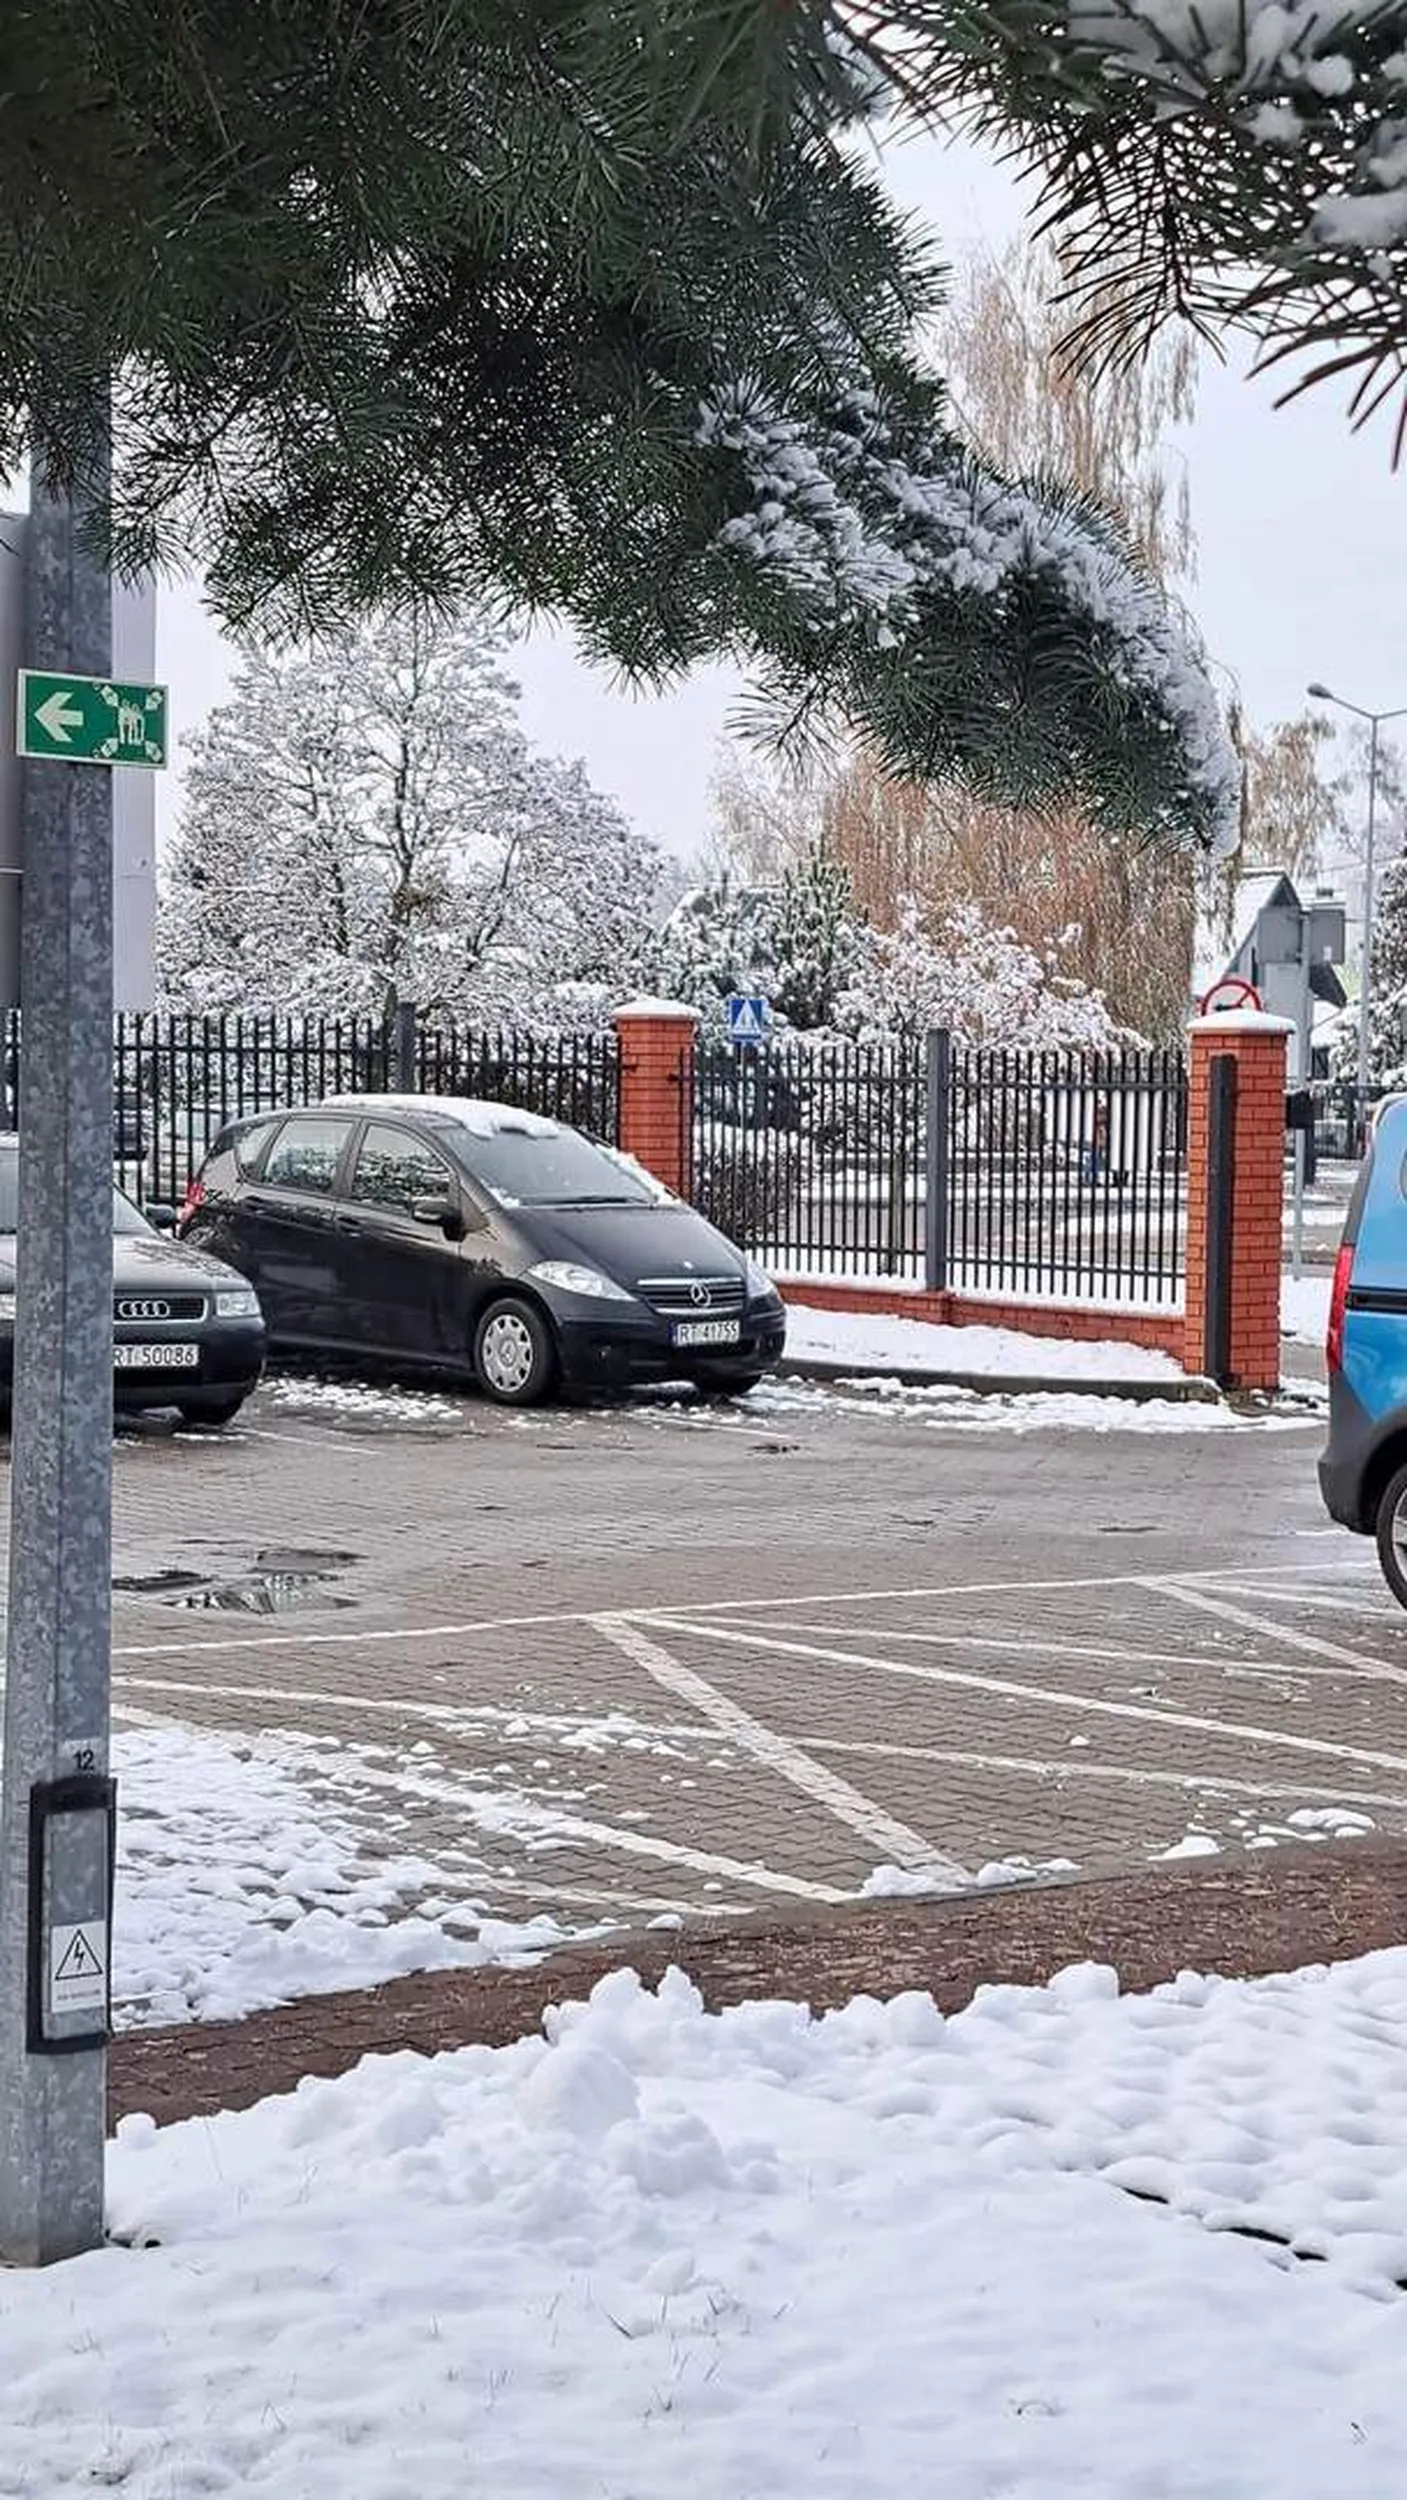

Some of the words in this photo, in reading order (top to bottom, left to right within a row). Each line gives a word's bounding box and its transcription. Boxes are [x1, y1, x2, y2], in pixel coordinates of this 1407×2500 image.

[680, 1325, 698, 1342] RT
[112, 1346, 134, 1365] RT
[73, 1749, 94, 1771] 12
